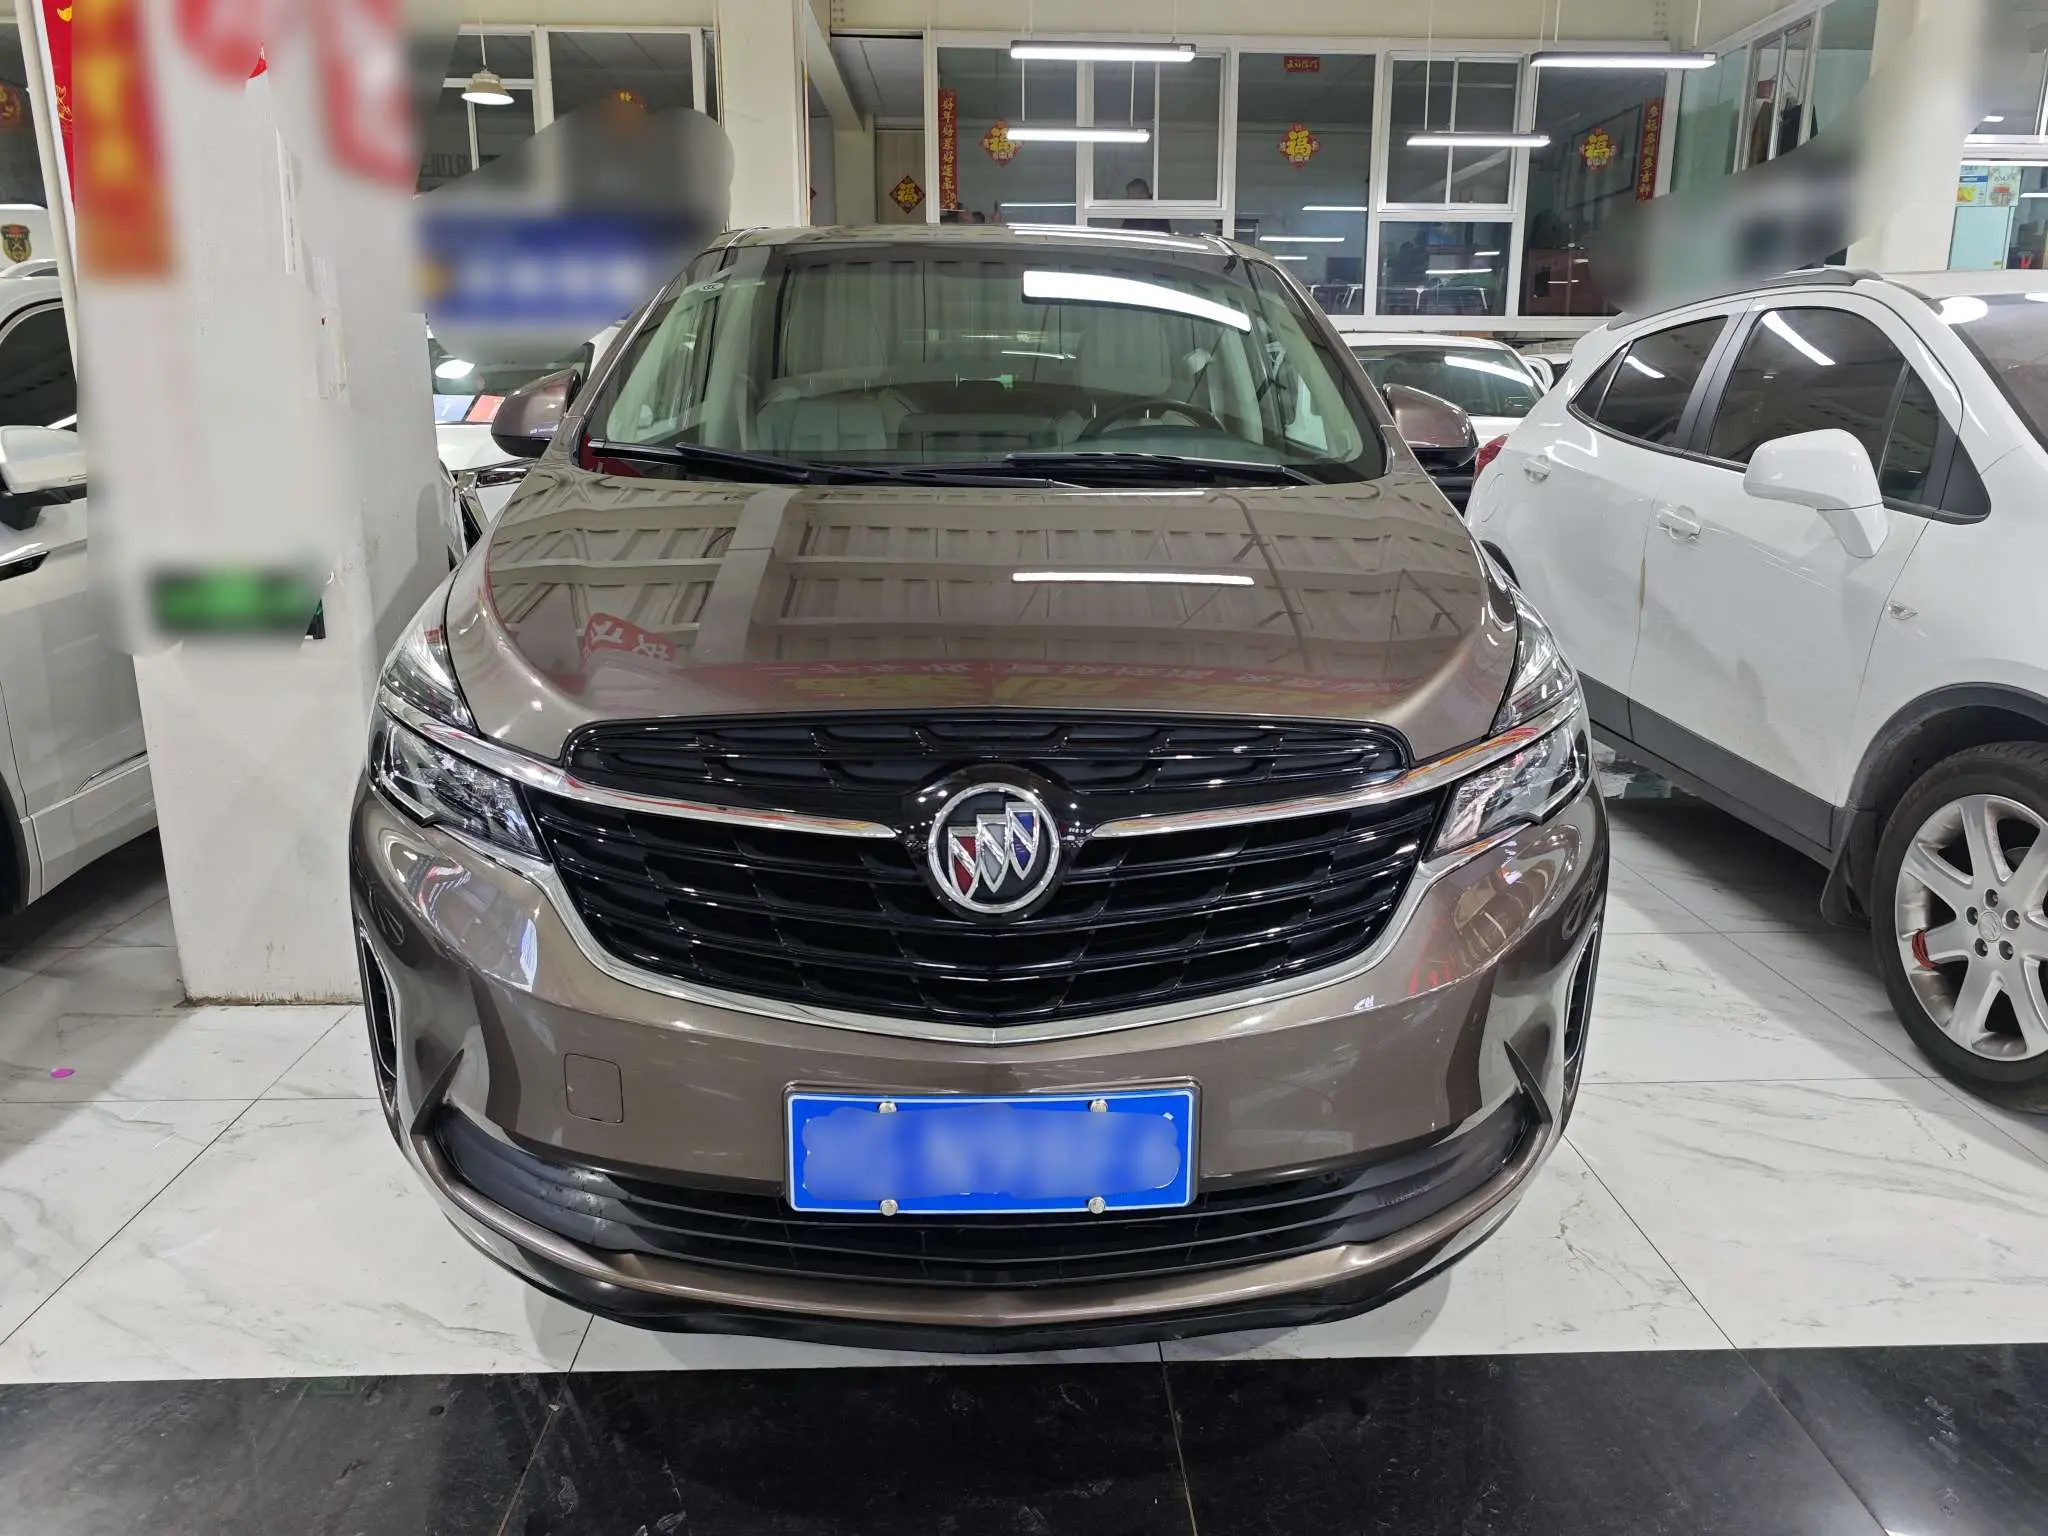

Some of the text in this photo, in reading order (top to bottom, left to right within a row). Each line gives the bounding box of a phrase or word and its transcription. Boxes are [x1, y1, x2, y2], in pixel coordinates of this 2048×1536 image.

[1286, 130, 1312, 156] 福
[1584, 134, 1610, 160] 福
[897, 183, 918, 203] 福
